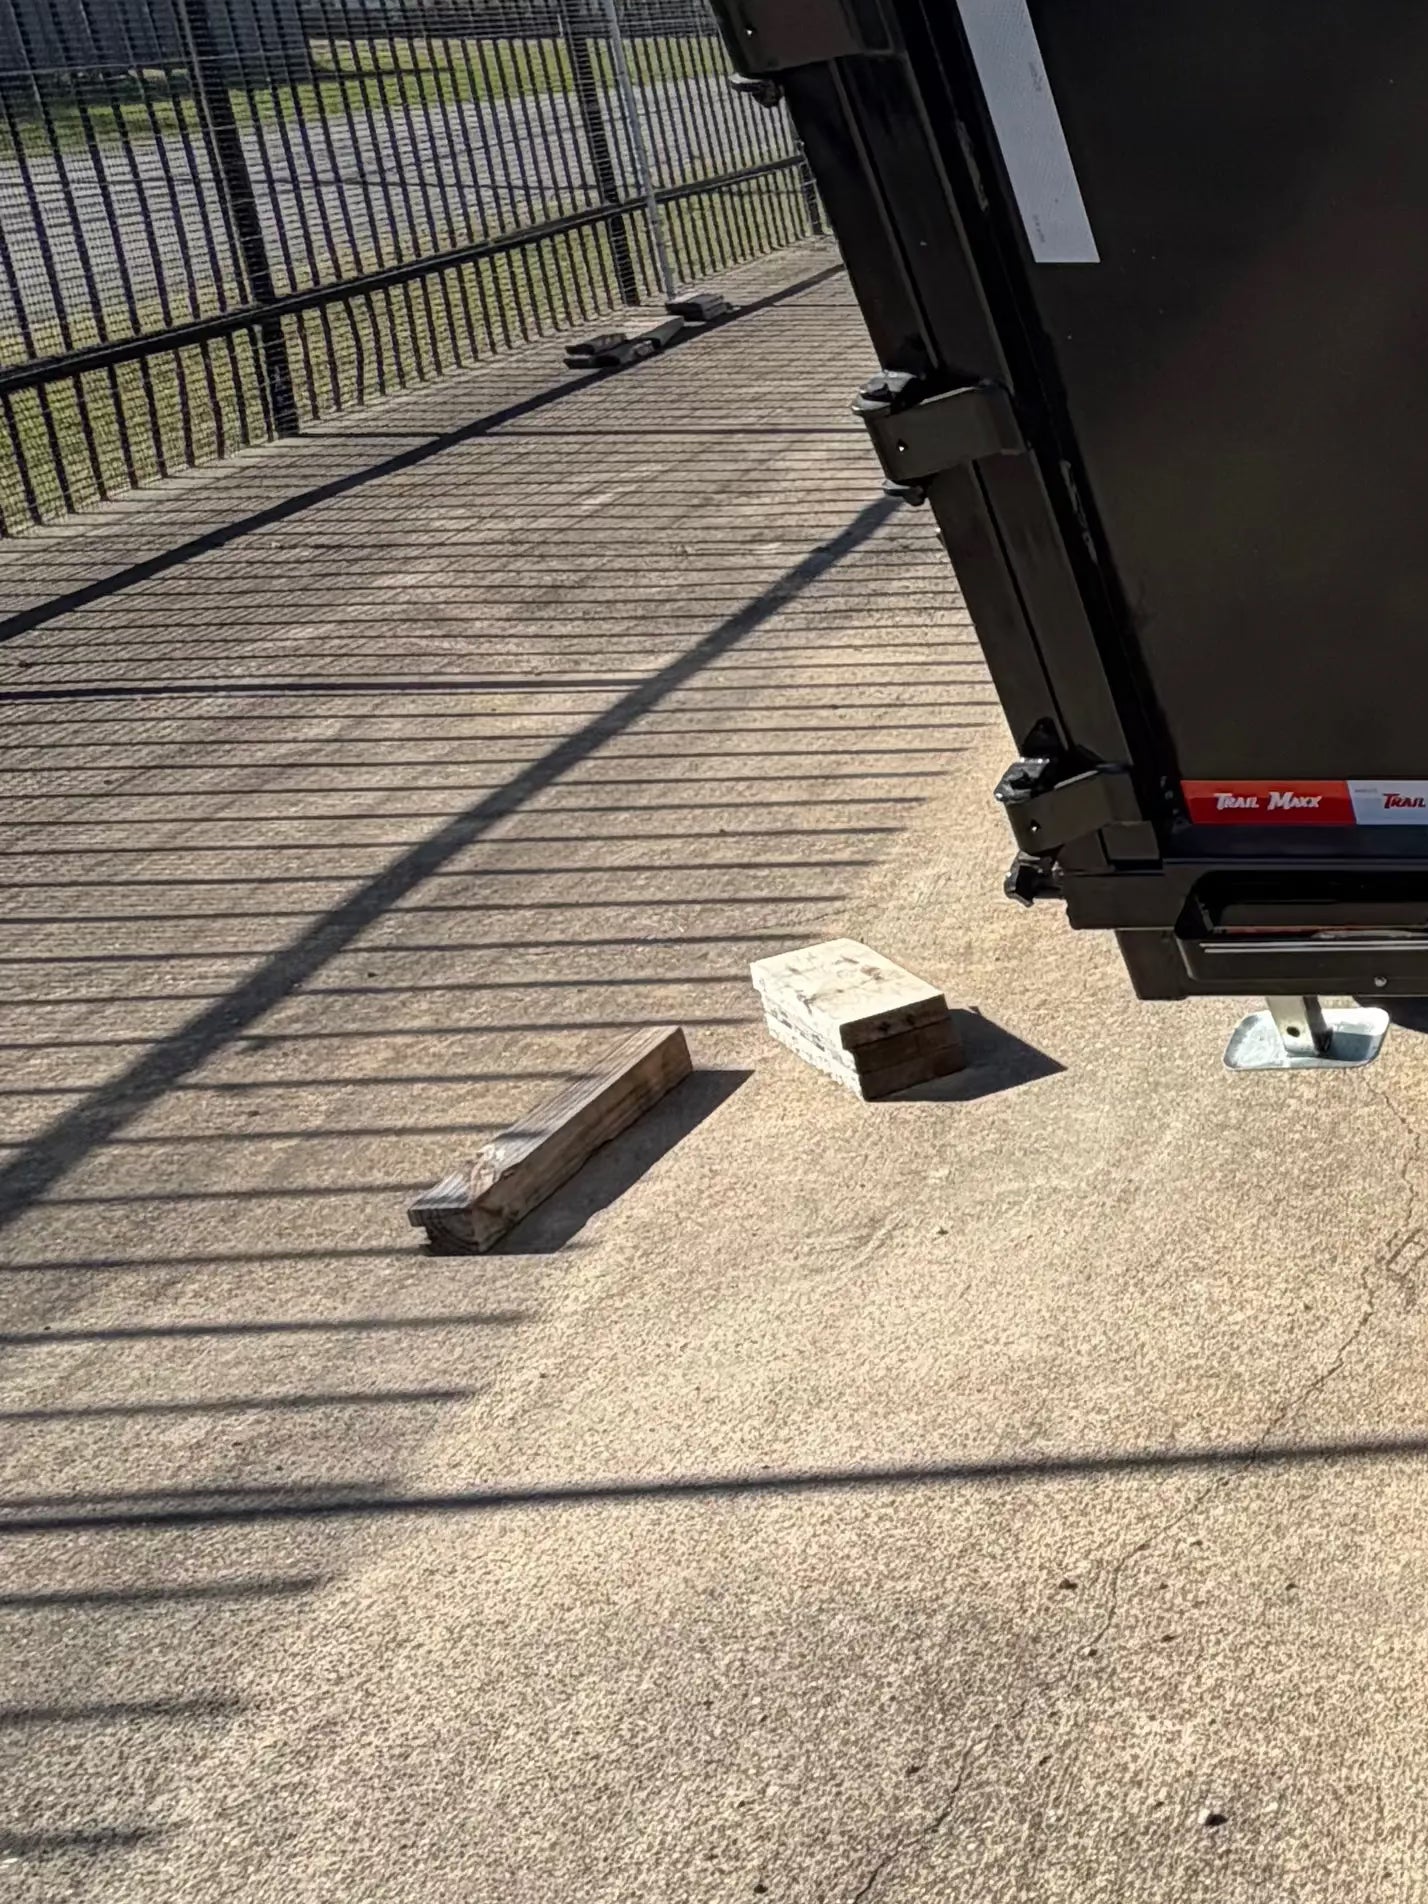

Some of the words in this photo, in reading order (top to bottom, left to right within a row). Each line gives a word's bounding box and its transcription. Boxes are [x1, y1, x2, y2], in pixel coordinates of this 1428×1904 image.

[1214, 793, 1259, 810] TRAIL
[1267, 791, 1322, 809] MAXX
[1382, 793, 1426, 809] TRAIL
